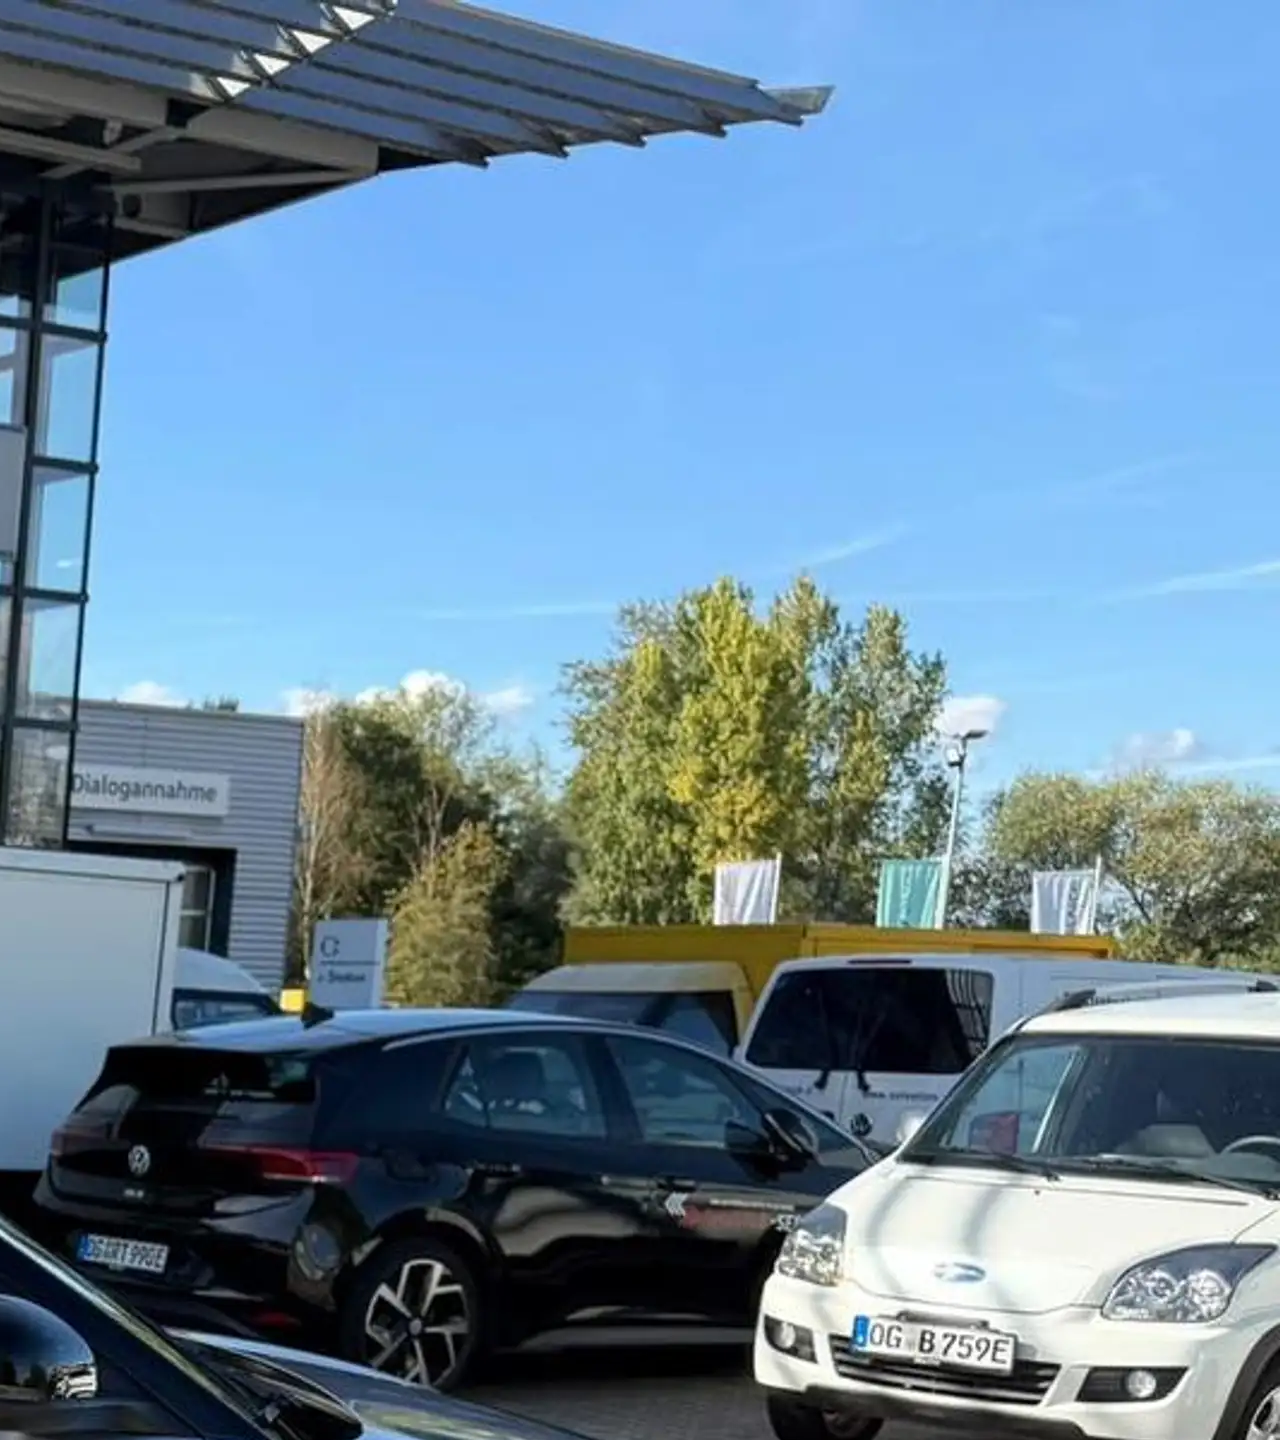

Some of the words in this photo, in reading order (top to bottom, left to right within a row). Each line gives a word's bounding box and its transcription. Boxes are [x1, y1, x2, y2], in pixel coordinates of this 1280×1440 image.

[72, 773, 218, 802] Dialogannahme
[869, 1323, 903, 1349] OG
[919, 1329, 936, 1354] B
[941, 1332, 1010, 1365] 759E
